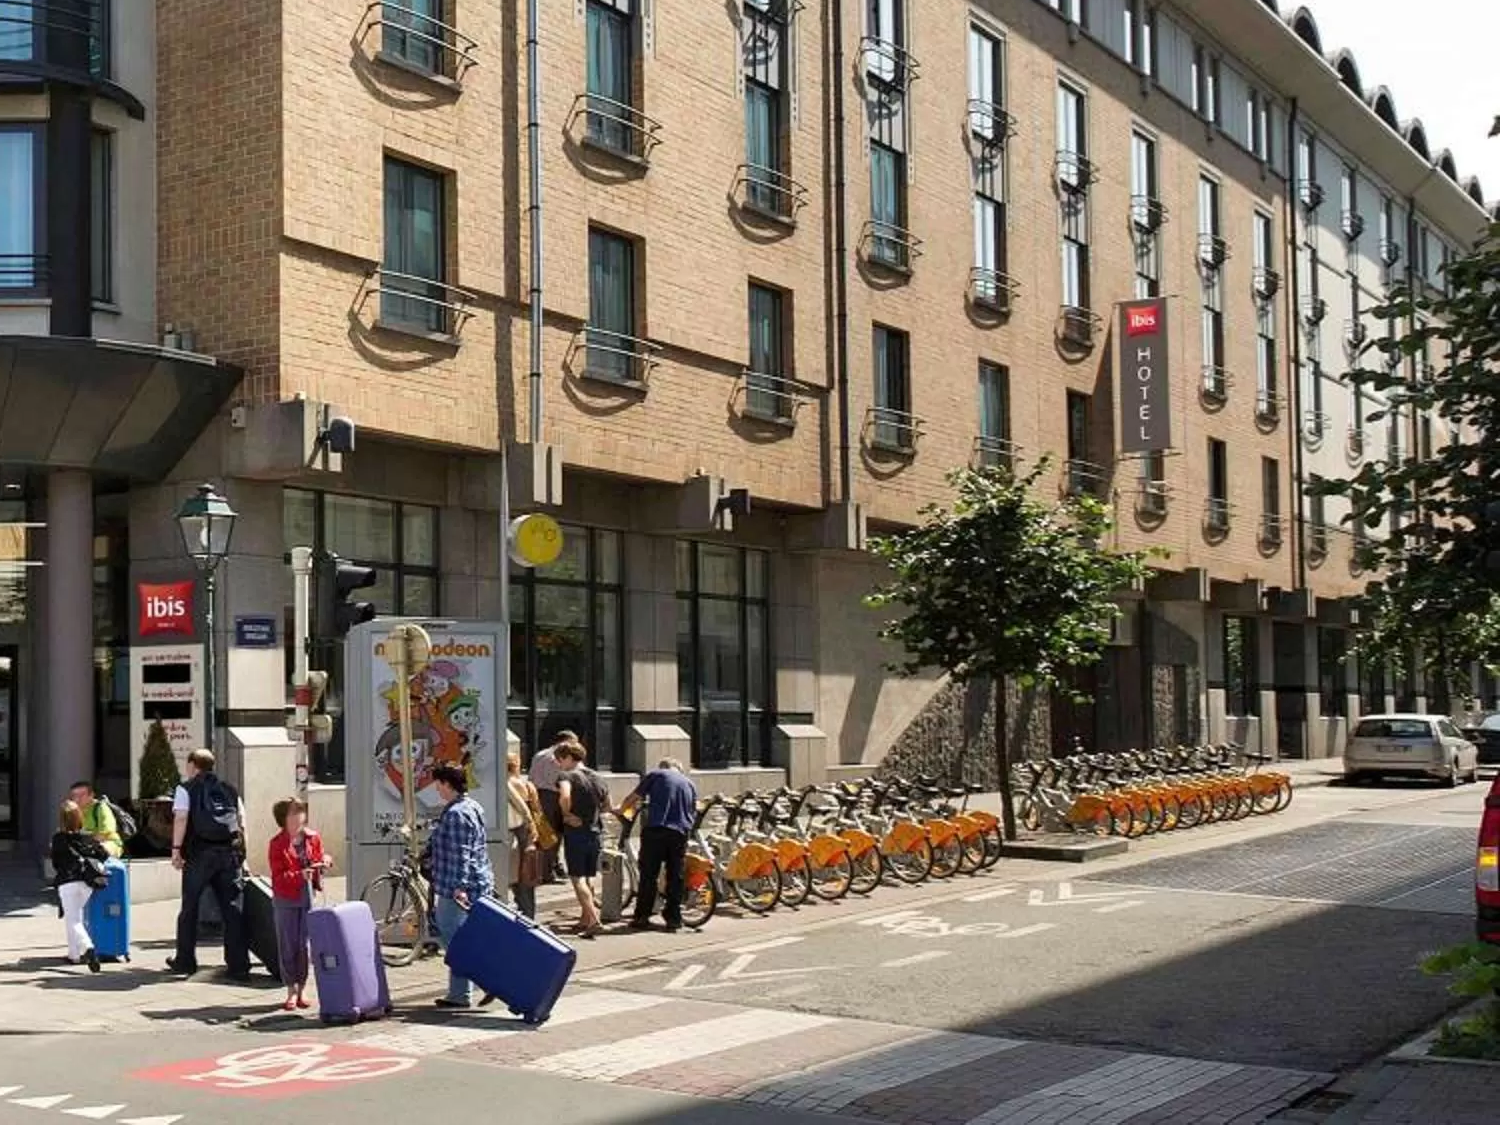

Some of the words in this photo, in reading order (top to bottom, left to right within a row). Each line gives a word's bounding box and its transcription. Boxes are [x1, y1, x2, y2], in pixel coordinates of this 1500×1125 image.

[1131, 315, 1156, 328] ibis
[1137, 347, 1151, 440] HOTEL
[147, 595, 186, 618] ibis
